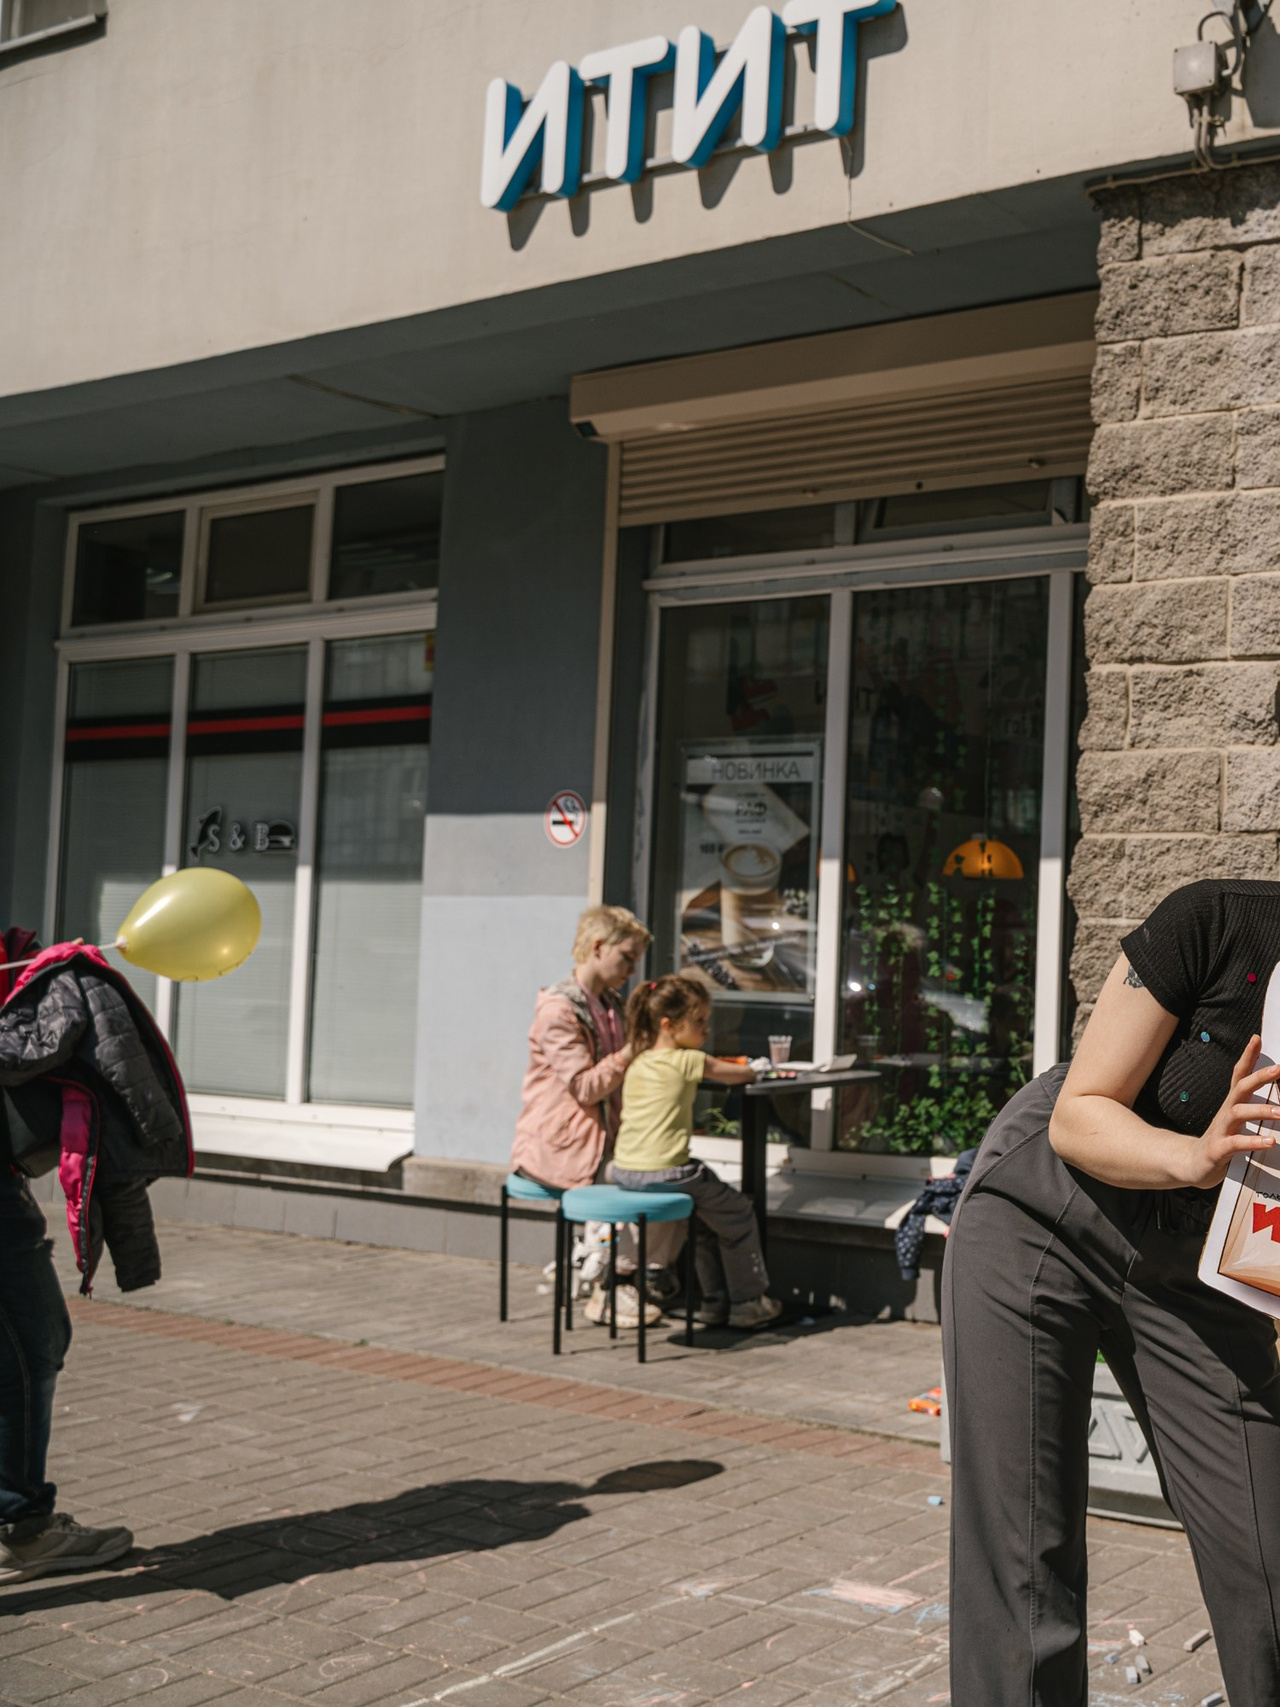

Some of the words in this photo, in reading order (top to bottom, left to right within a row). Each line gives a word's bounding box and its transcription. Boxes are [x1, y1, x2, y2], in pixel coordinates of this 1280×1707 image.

[481, 0, 898, 212] ИТИТ
[711, 761, 802, 781] НОВИНКА
[207, 823, 220, 853] S
[229, 821, 245, 852] &
[254, 821, 269, 852] B
